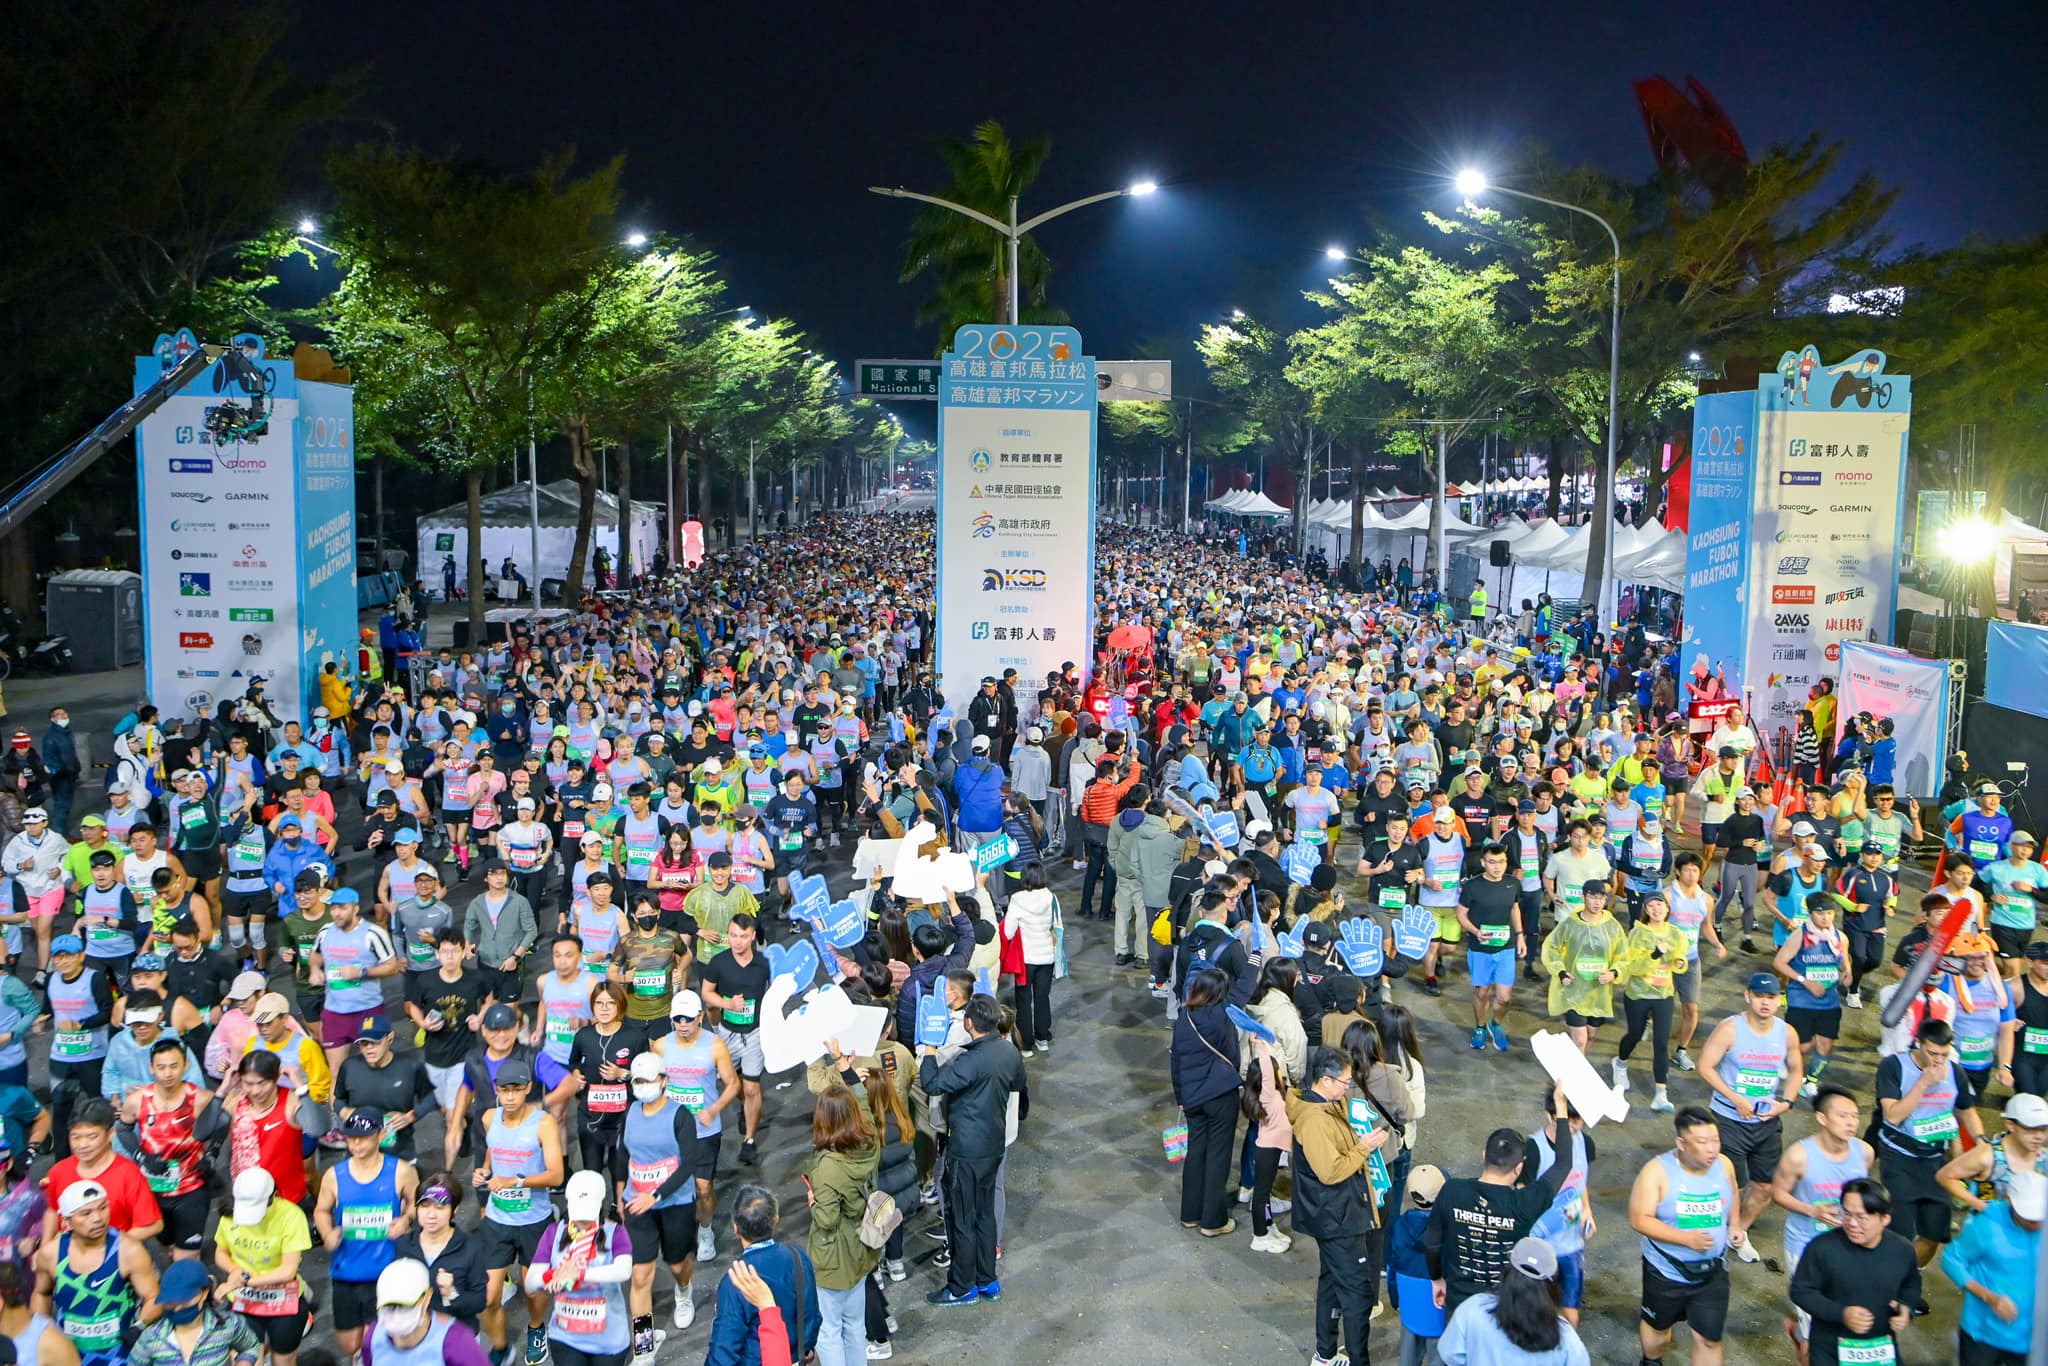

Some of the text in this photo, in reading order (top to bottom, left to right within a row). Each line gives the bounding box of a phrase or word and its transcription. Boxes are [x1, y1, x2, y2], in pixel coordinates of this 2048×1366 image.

[963, 329, 1070, 361] 2025
[871, 368, 931, 381] 國家體
[950, 360, 1086, 380] 高雄富邦馬拉松
[871, 384, 921, 393] National
[951, 387, 1084, 405] 高雄富邦マラソン
[305, 418, 348, 449] 2025
[1697, 425, 1744, 457] 2025
[1000, 453, 1063, 463] 教育部體育署
[1810, 444, 1870, 458] 富邦人壽
[227, 460, 266, 469] momo
[1834, 472, 1872, 481] momo
[985, 484, 1062, 495] 中華民國田徑協會
[1779, 504, 1810, 512] saucony
[1829, 505, 1872, 513] GARMIN
[308, 511, 351, 550] KAOHSIUNG
[999, 520, 1051, 530] 高雄市政府
[1693, 521, 1739, 552] KAOHSIUNG
[325, 530, 351, 559] FUBON
[1709, 541, 1739, 566] FUBON
[309, 550, 352, 589] MARATHON
[1691, 560, 1738, 588] MARATHON
[1005, 569, 1046, 587] KSD
[1825, 587, 1864, 605] 即攻元氣
[1775, 614, 1809, 627] SAVAS
[1825, 618, 1864, 632] 康貝特
[994, 627, 1057, 642] 富邦人壽
[1015, 679, 1047, 689] 動筆記
[978, 843, 1005, 863] 6666
[636, 977, 661, 986] 30721
[1742, 1078, 1772, 1087] 34494
[592, 1092, 622, 1101] 40171
[1453, 1209, 1515, 1227] THREE PEAT
[72, 1322, 112, 1336] 30105
